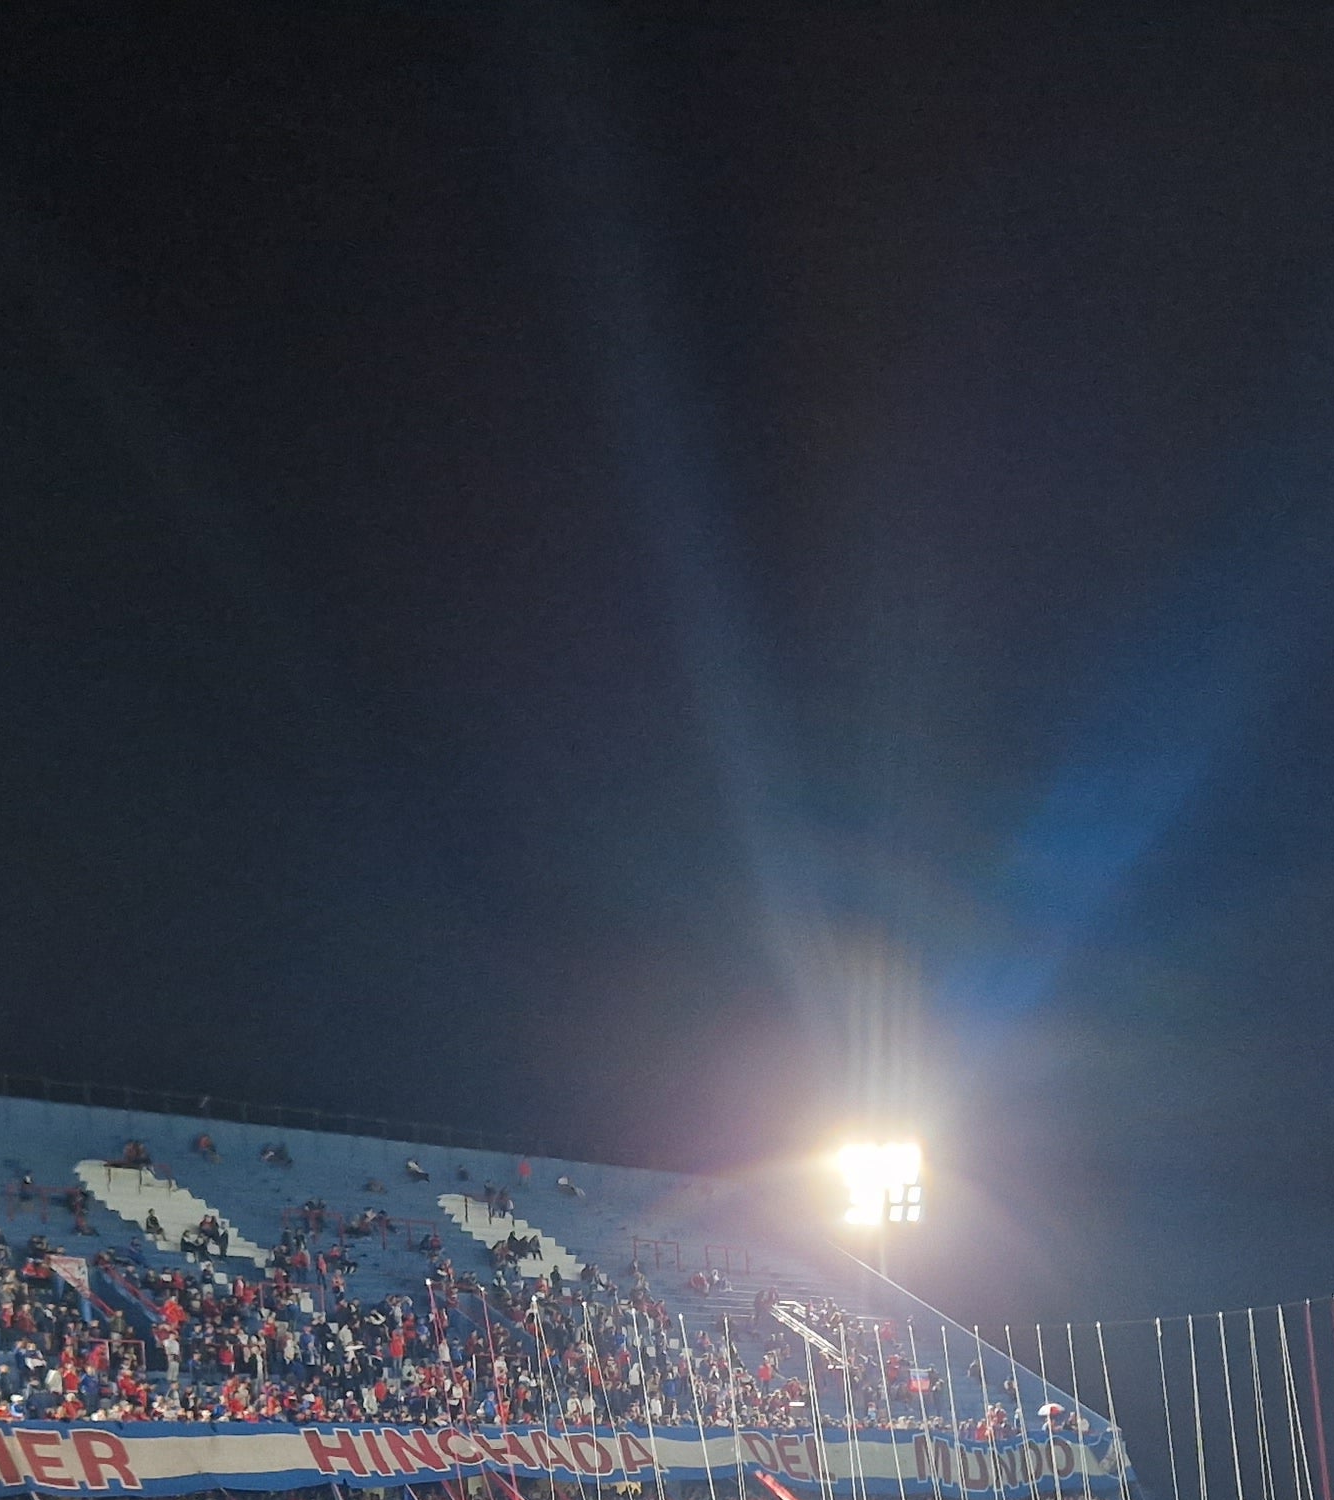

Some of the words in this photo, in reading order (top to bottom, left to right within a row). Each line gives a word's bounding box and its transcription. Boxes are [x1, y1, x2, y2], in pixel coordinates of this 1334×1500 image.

[300, 1427, 665, 1477] HINCHADA
[741, 1431, 838, 1484] DEL
[913, 1431, 1078, 1493] MUNDO
